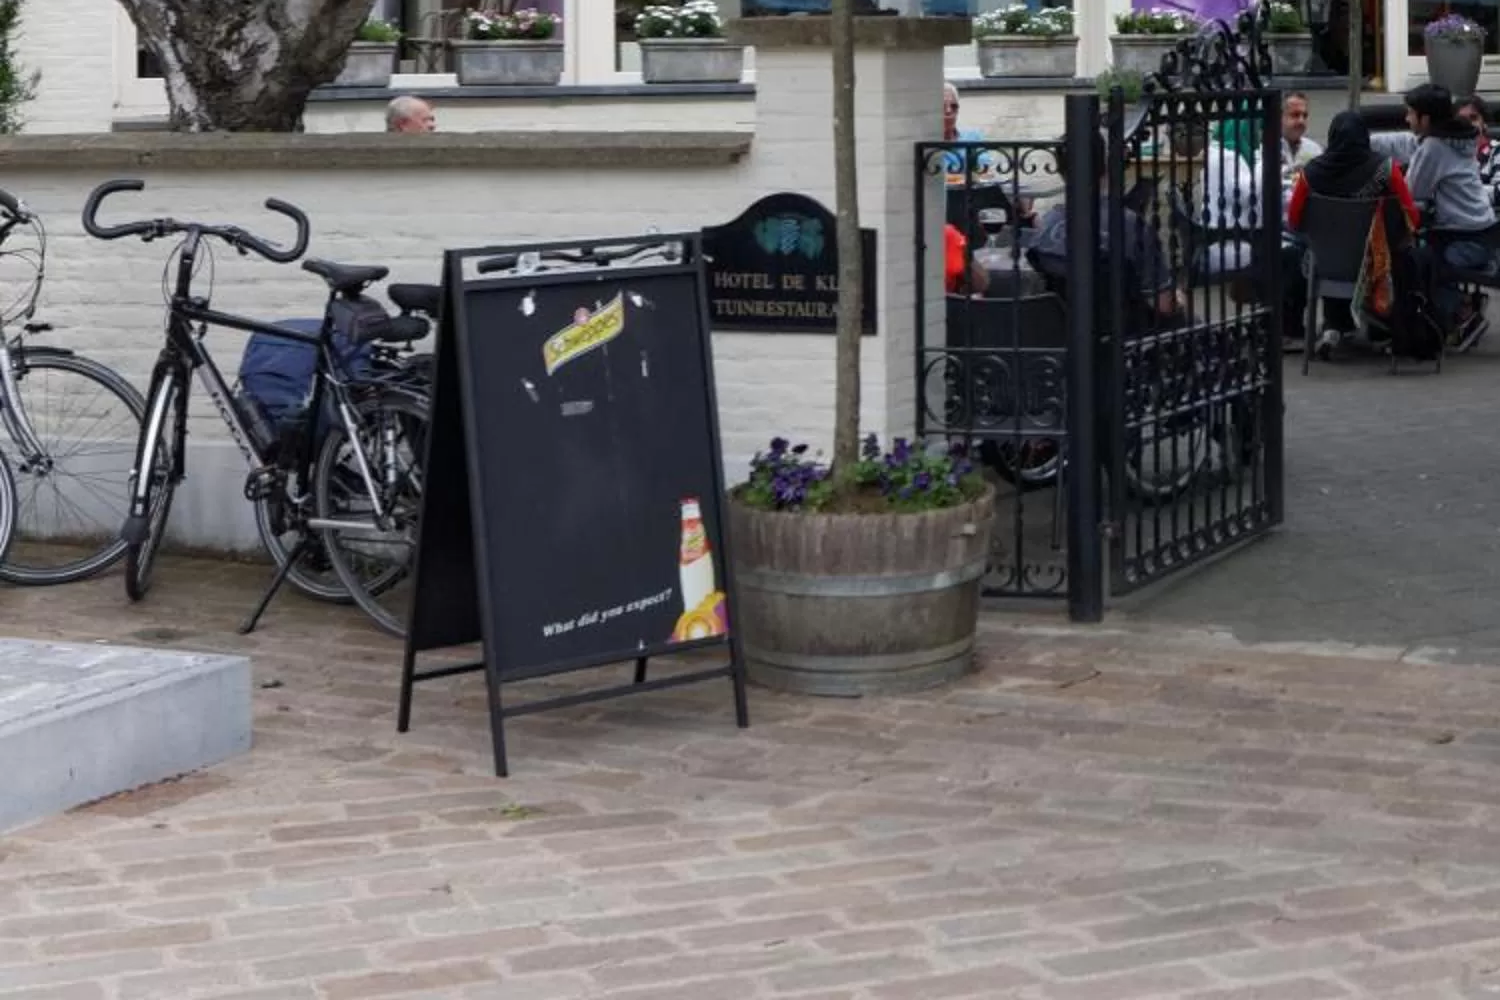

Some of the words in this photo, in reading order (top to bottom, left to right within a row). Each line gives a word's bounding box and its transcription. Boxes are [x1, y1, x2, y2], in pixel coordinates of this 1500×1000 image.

[713, 271, 776, 290] HOTEL
[782, 273, 806, 290] DE
[712, 299, 840, 318] TUINRESTAURA
[543, 619, 575, 637] What
[577, 610, 599, 627] did
[600, 605, 624, 623] you
